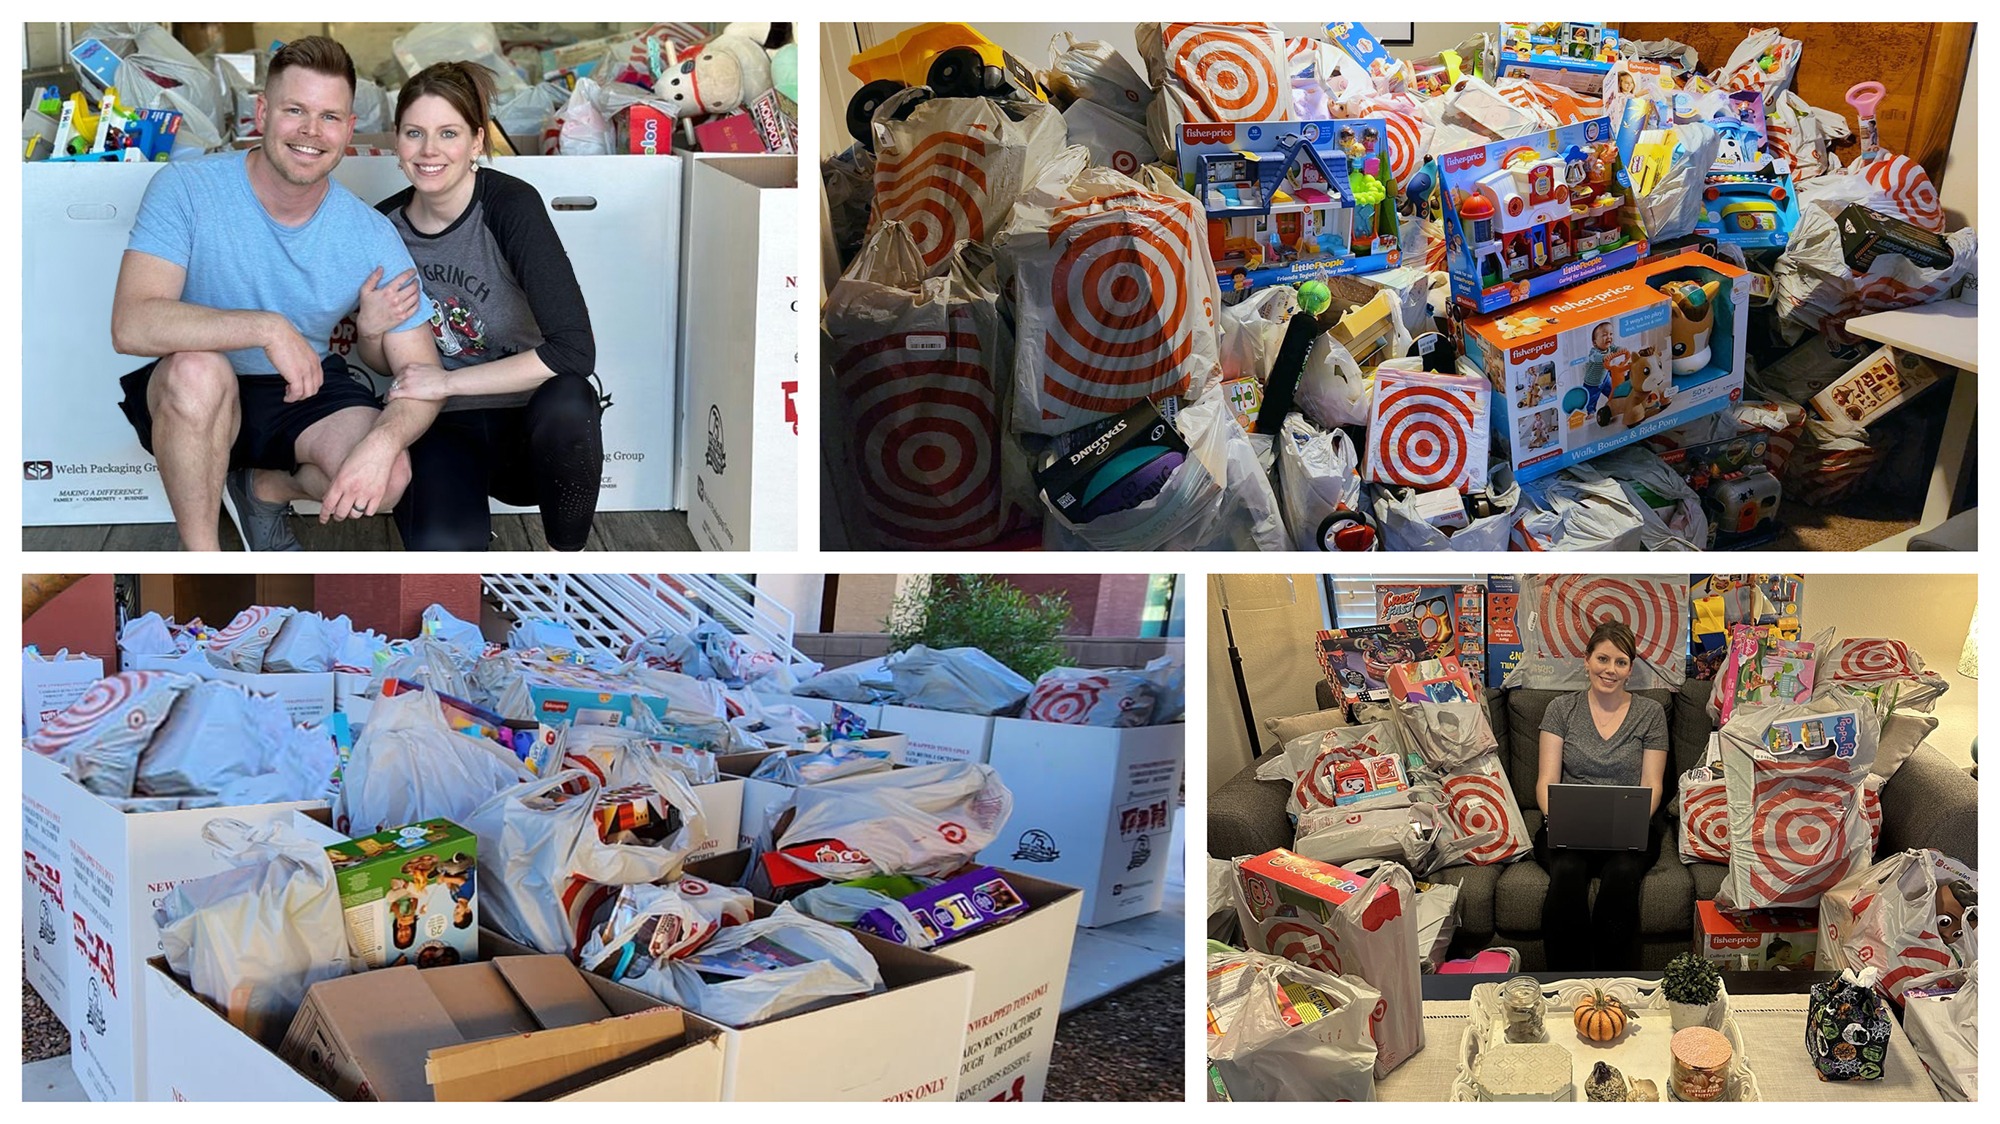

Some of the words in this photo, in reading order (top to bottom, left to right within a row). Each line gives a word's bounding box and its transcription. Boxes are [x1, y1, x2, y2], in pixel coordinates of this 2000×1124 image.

[759, 98, 782, 150] MONOPOLY
[1186, 128, 1233, 139] fisher-price
[1447, 152, 1485, 166] fisher-price
[423, 264, 491, 303] GRINCH
[1549, 284, 1635, 314] fisher-price
[1512, 341, 1555, 359] fisher-price
[1070, 419, 1128, 466] SPALDING
[1571, 447, 1596, 460] Walk,
[1597, 435, 1628, 450] Bounce
[1630, 430, 1637, 438] &
[1639, 424, 1657, 435] Ride
[1658, 417, 1678, 429] Pony
[613, 451, 645, 462] Group
[55, 463, 88, 474] Welch
[90, 463, 142, 475] Packaging
[1383, 586, 1420, 608] CRAZY
[1386, 602, 1416, 621] FAST
[1836, 717, 1852, 743] Peppa
[1839, 742, 1853, 756] Pig
[147, 882, 177, 894] NEW
[431, 925, 442, 938] 23
[1713, 936, 1758, 945] fisher-price
[1013, 992, 1031, 1012] TOYS
[1031, 982, 1049, 1001] ONLY
[1308, 990, 1319, 1005] THE
[983, 1028, 1005, 1049] RUNS
[1009, 1006, 1042, 1034] OCTOBER
[993, 1026, 1033, 1058] DECEMBER
[915, 1076, 948, 1100] ONLY
